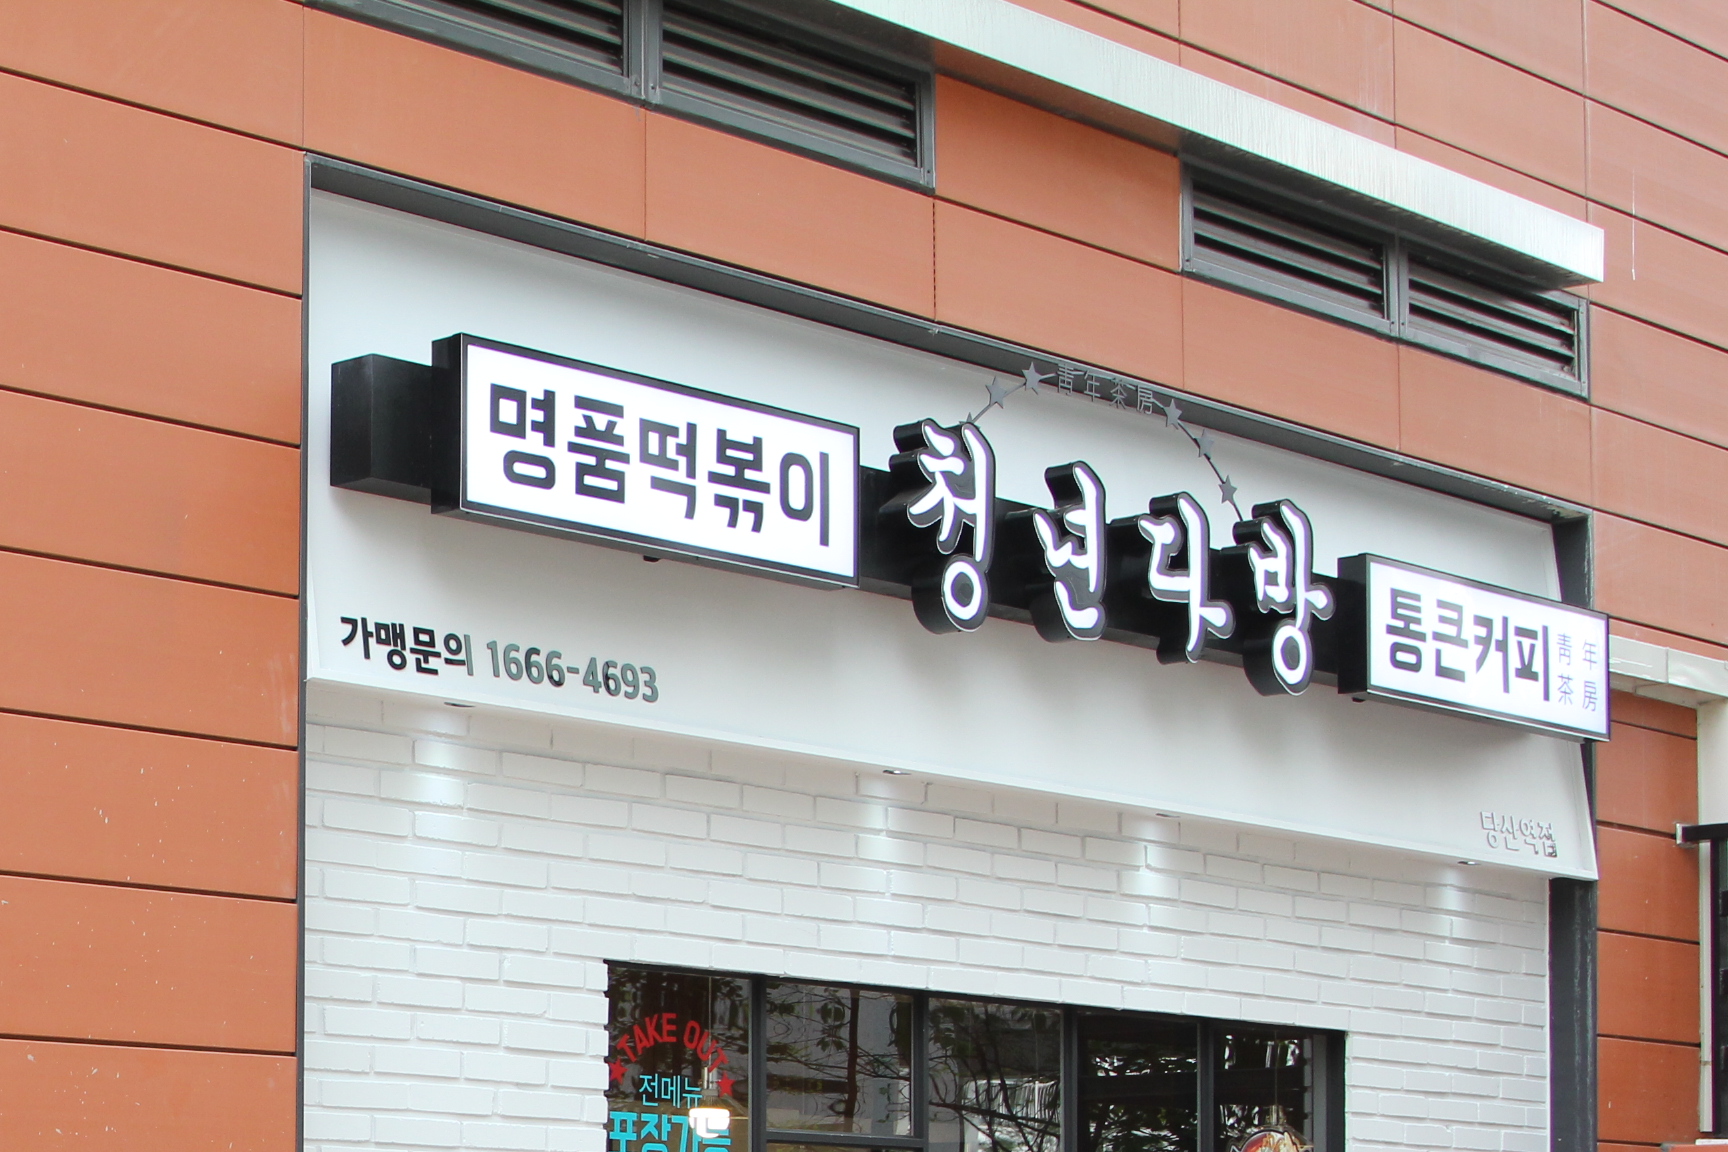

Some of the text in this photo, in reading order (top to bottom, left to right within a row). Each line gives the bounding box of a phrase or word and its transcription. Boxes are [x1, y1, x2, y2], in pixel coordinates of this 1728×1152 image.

[489, 381, 831, 548] 명품떡볶이
[908, 419, 1336, 692] 청년다방
[340, 615, 660, 704] 가맹문의 1666-4693
[1385, 586, 1551, 702] 통큰커피
[1479, 811, 1559, 858] 당산역점
[616, 1013, 729, 1072] TAKE OUT
[639, 1074, 703, 1109] 전메뉴
